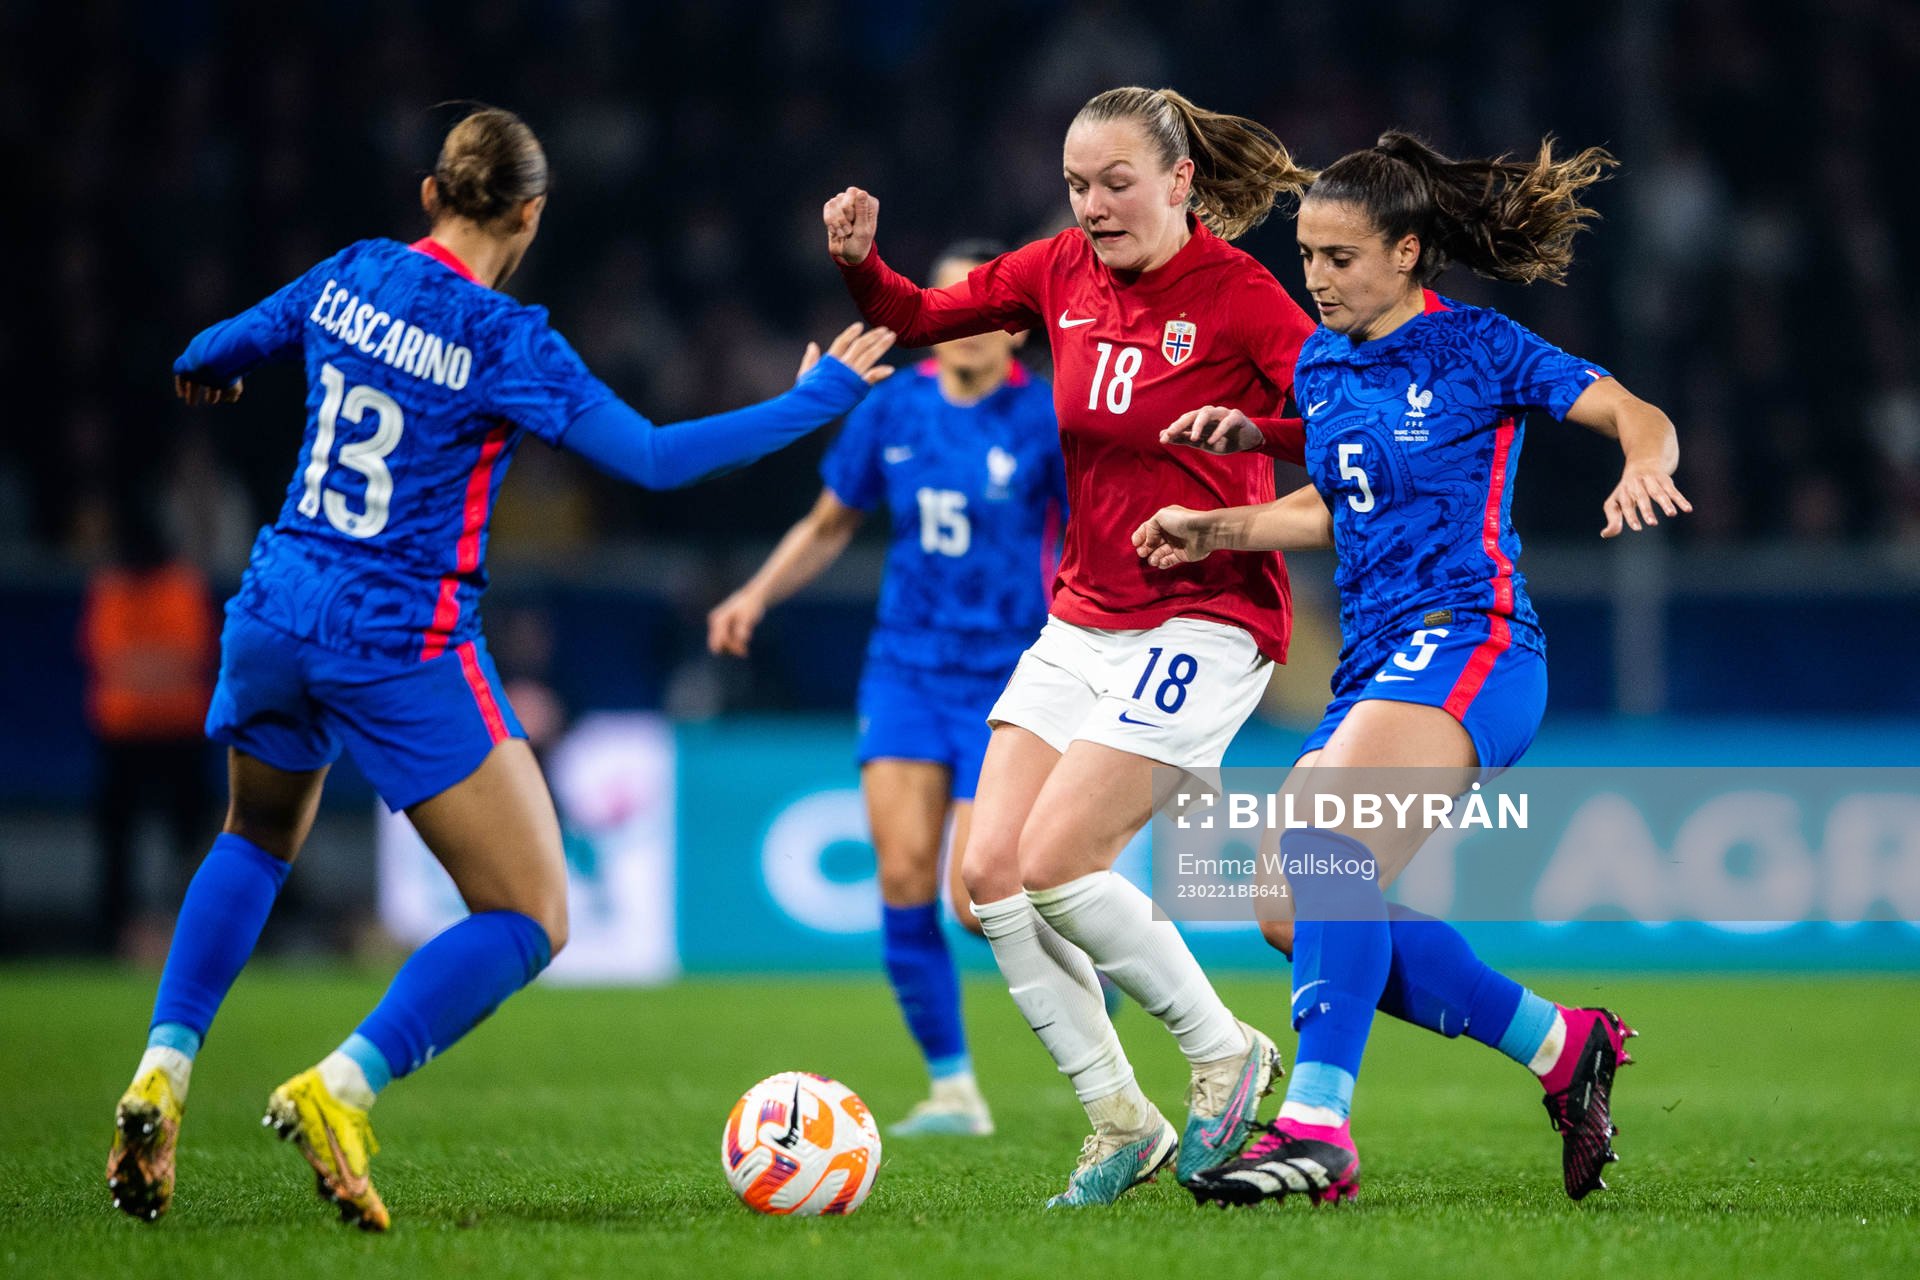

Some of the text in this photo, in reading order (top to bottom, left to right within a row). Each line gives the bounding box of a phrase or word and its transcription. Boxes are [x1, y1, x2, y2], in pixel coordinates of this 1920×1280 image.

[1088, 342, 1143, 414] 18
[297, 362, 405, 539] 13
[1337, 443, 1375, 513] 5
[916, 486, 972, 558] 15
[1131, 647, 1198, 714] 18
[1393, 628, 1449, 671] 5
